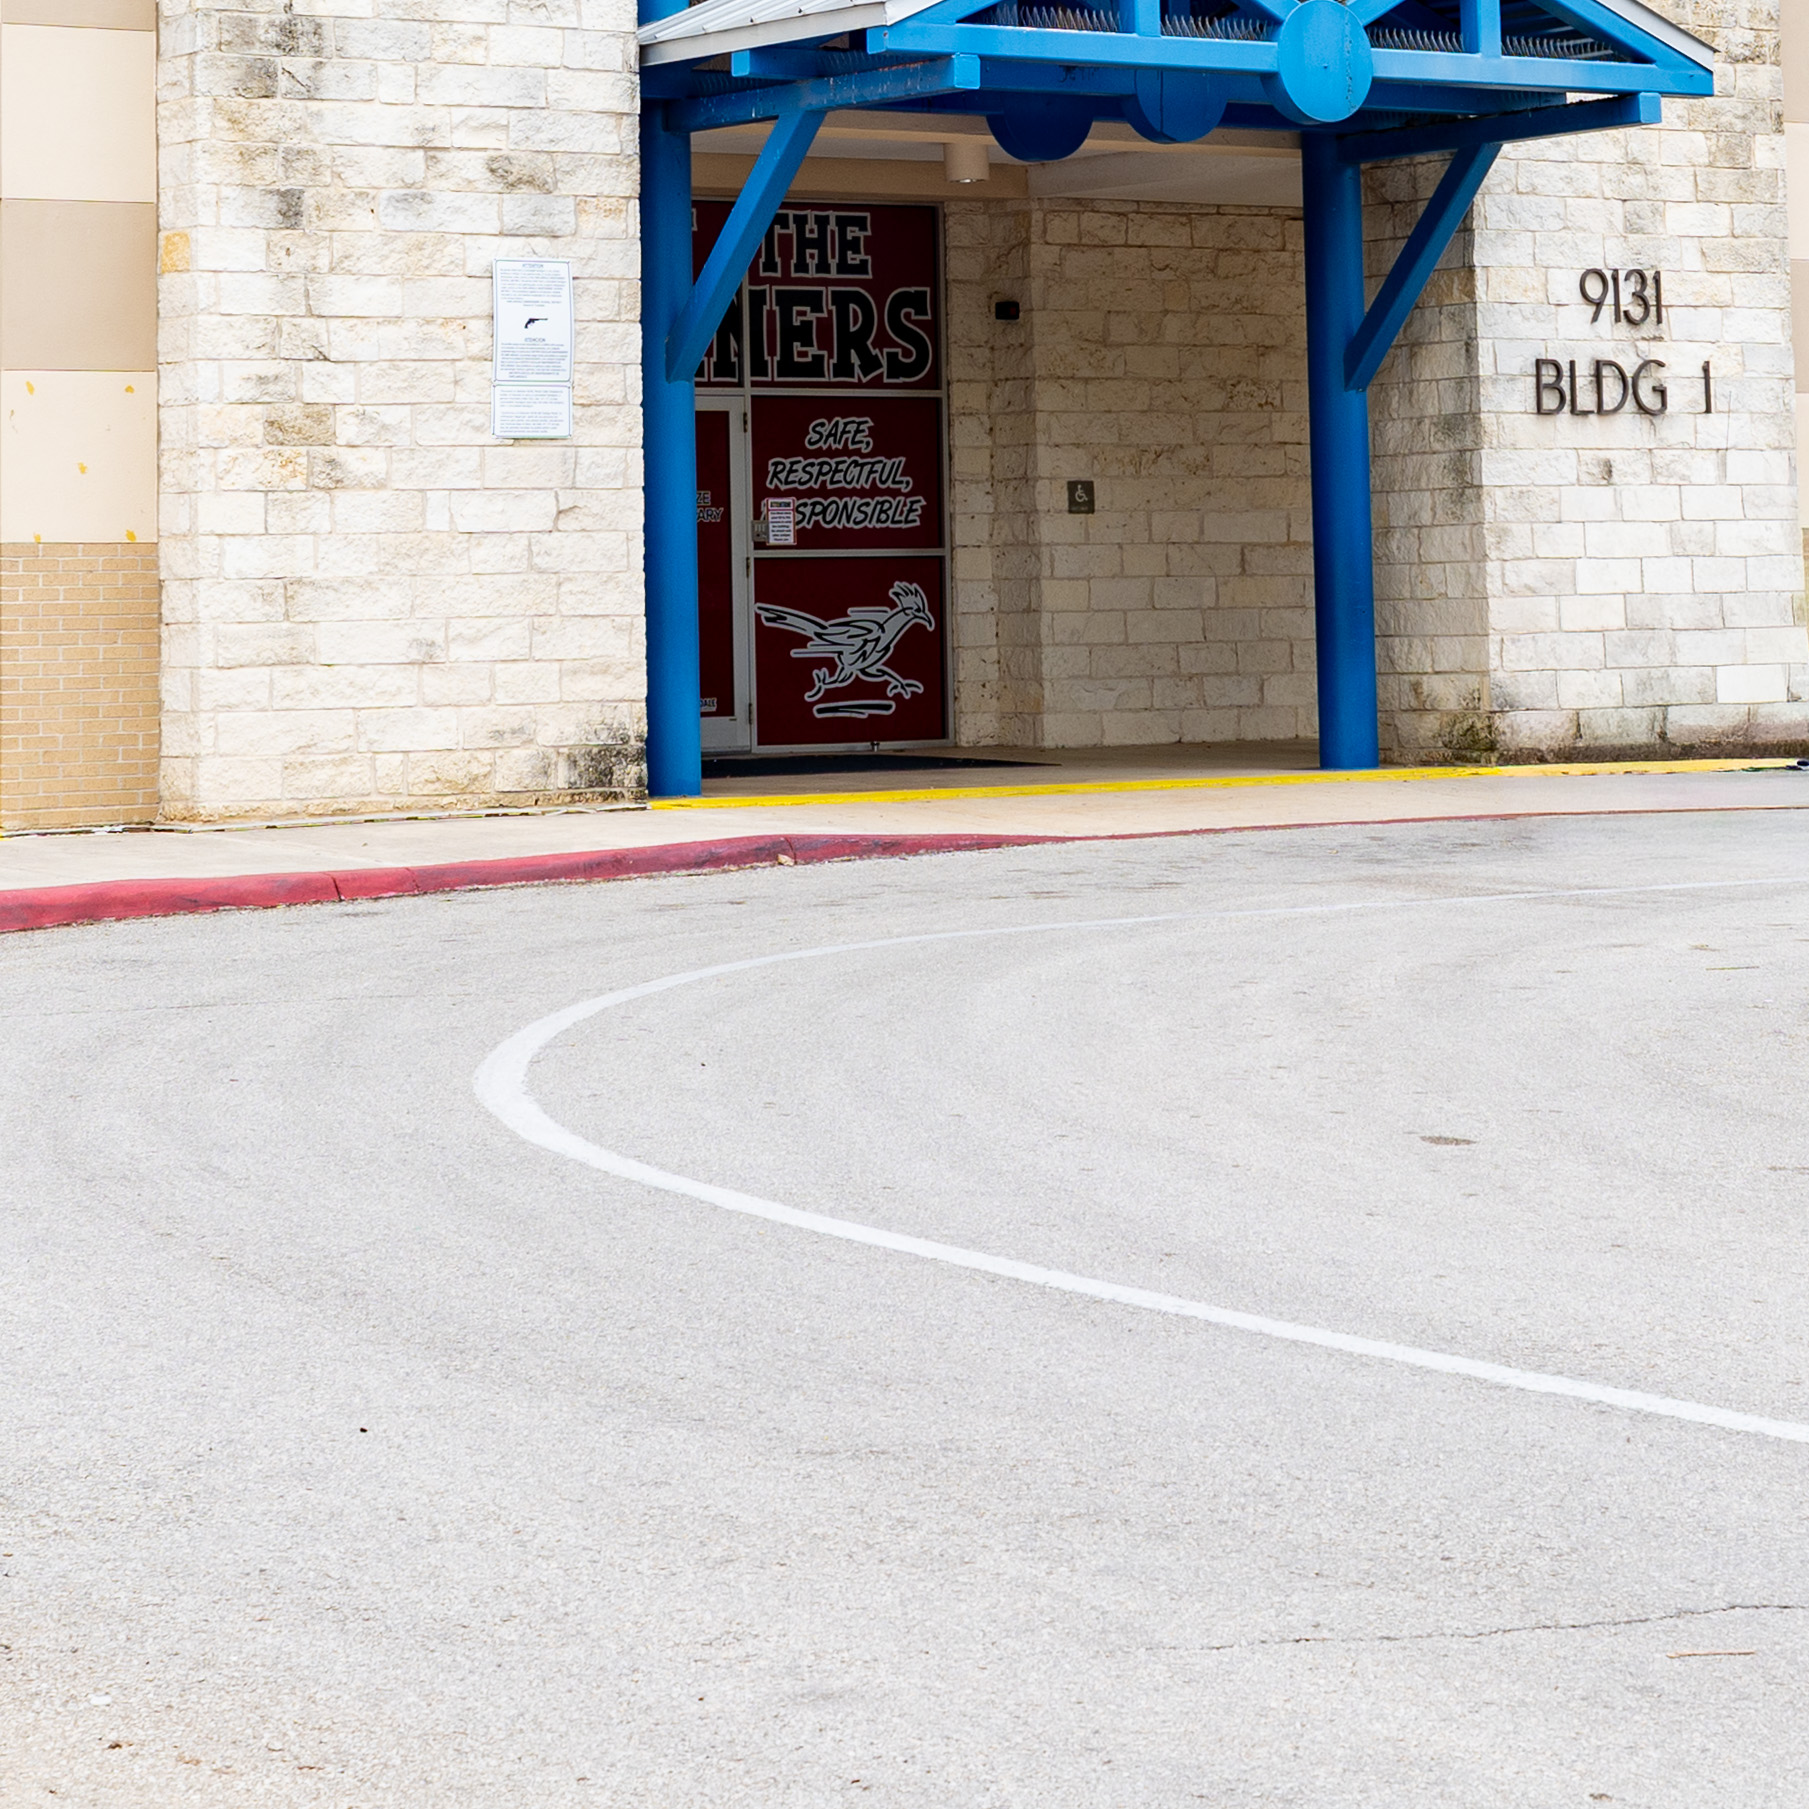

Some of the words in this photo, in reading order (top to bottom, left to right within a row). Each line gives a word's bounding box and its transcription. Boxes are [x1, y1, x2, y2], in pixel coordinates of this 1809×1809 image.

[759, 209, 872, 279] THE
[1579, 268, 1663, 325] 9131
[1535, 358, 1668, 416] BLDG
[1702, 360, 1712, 414] 1
[805, 417, 874, 453] SAFE,
[766, 456, 913, 492] RESPECTFUL,
[761, 496, 927, 529] SPONSIBLE
